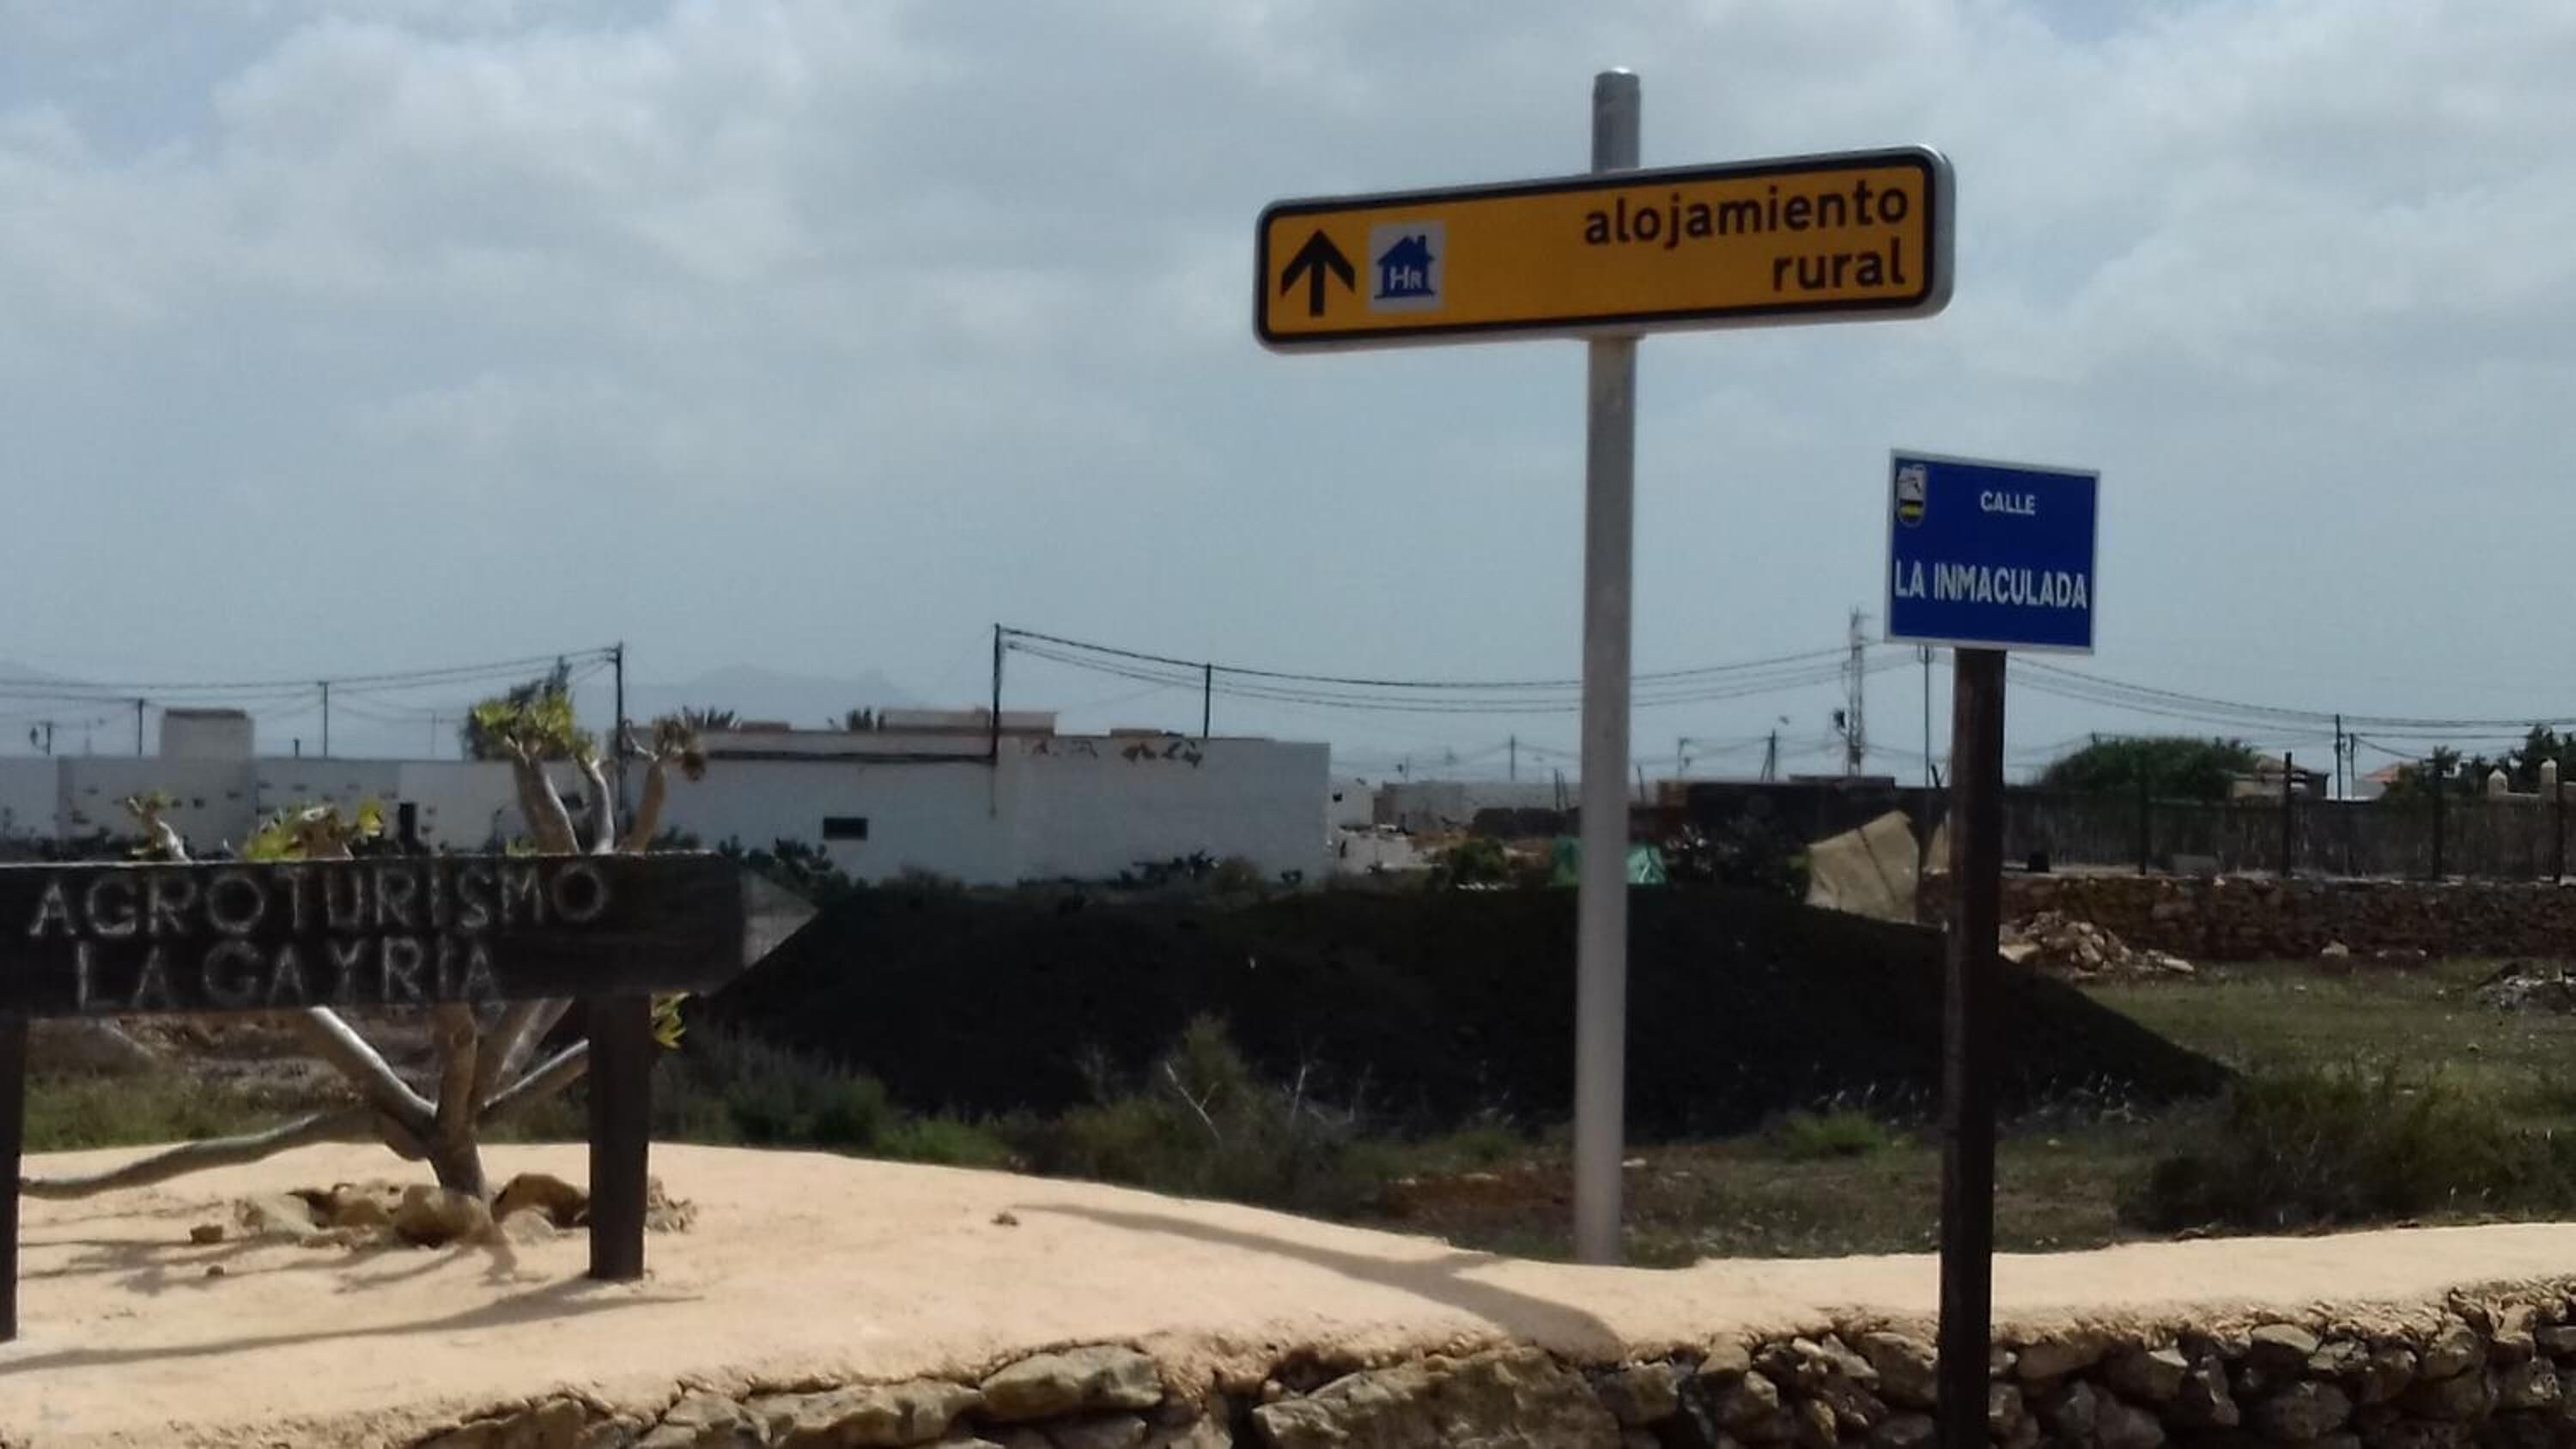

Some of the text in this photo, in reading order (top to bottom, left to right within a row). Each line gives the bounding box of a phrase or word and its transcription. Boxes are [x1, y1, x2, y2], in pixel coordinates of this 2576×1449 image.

[1584, 179, 1909, 251] alojamiento
[1772, 236, 1906, 292] rural
[1980, 490, 2036, 516] CALLE
[1894, 559, 2087, 609] LA INMACULADA
[28, 860, 607, 940] AGROTURISMO
[76, 940, 170, 1012] LA
